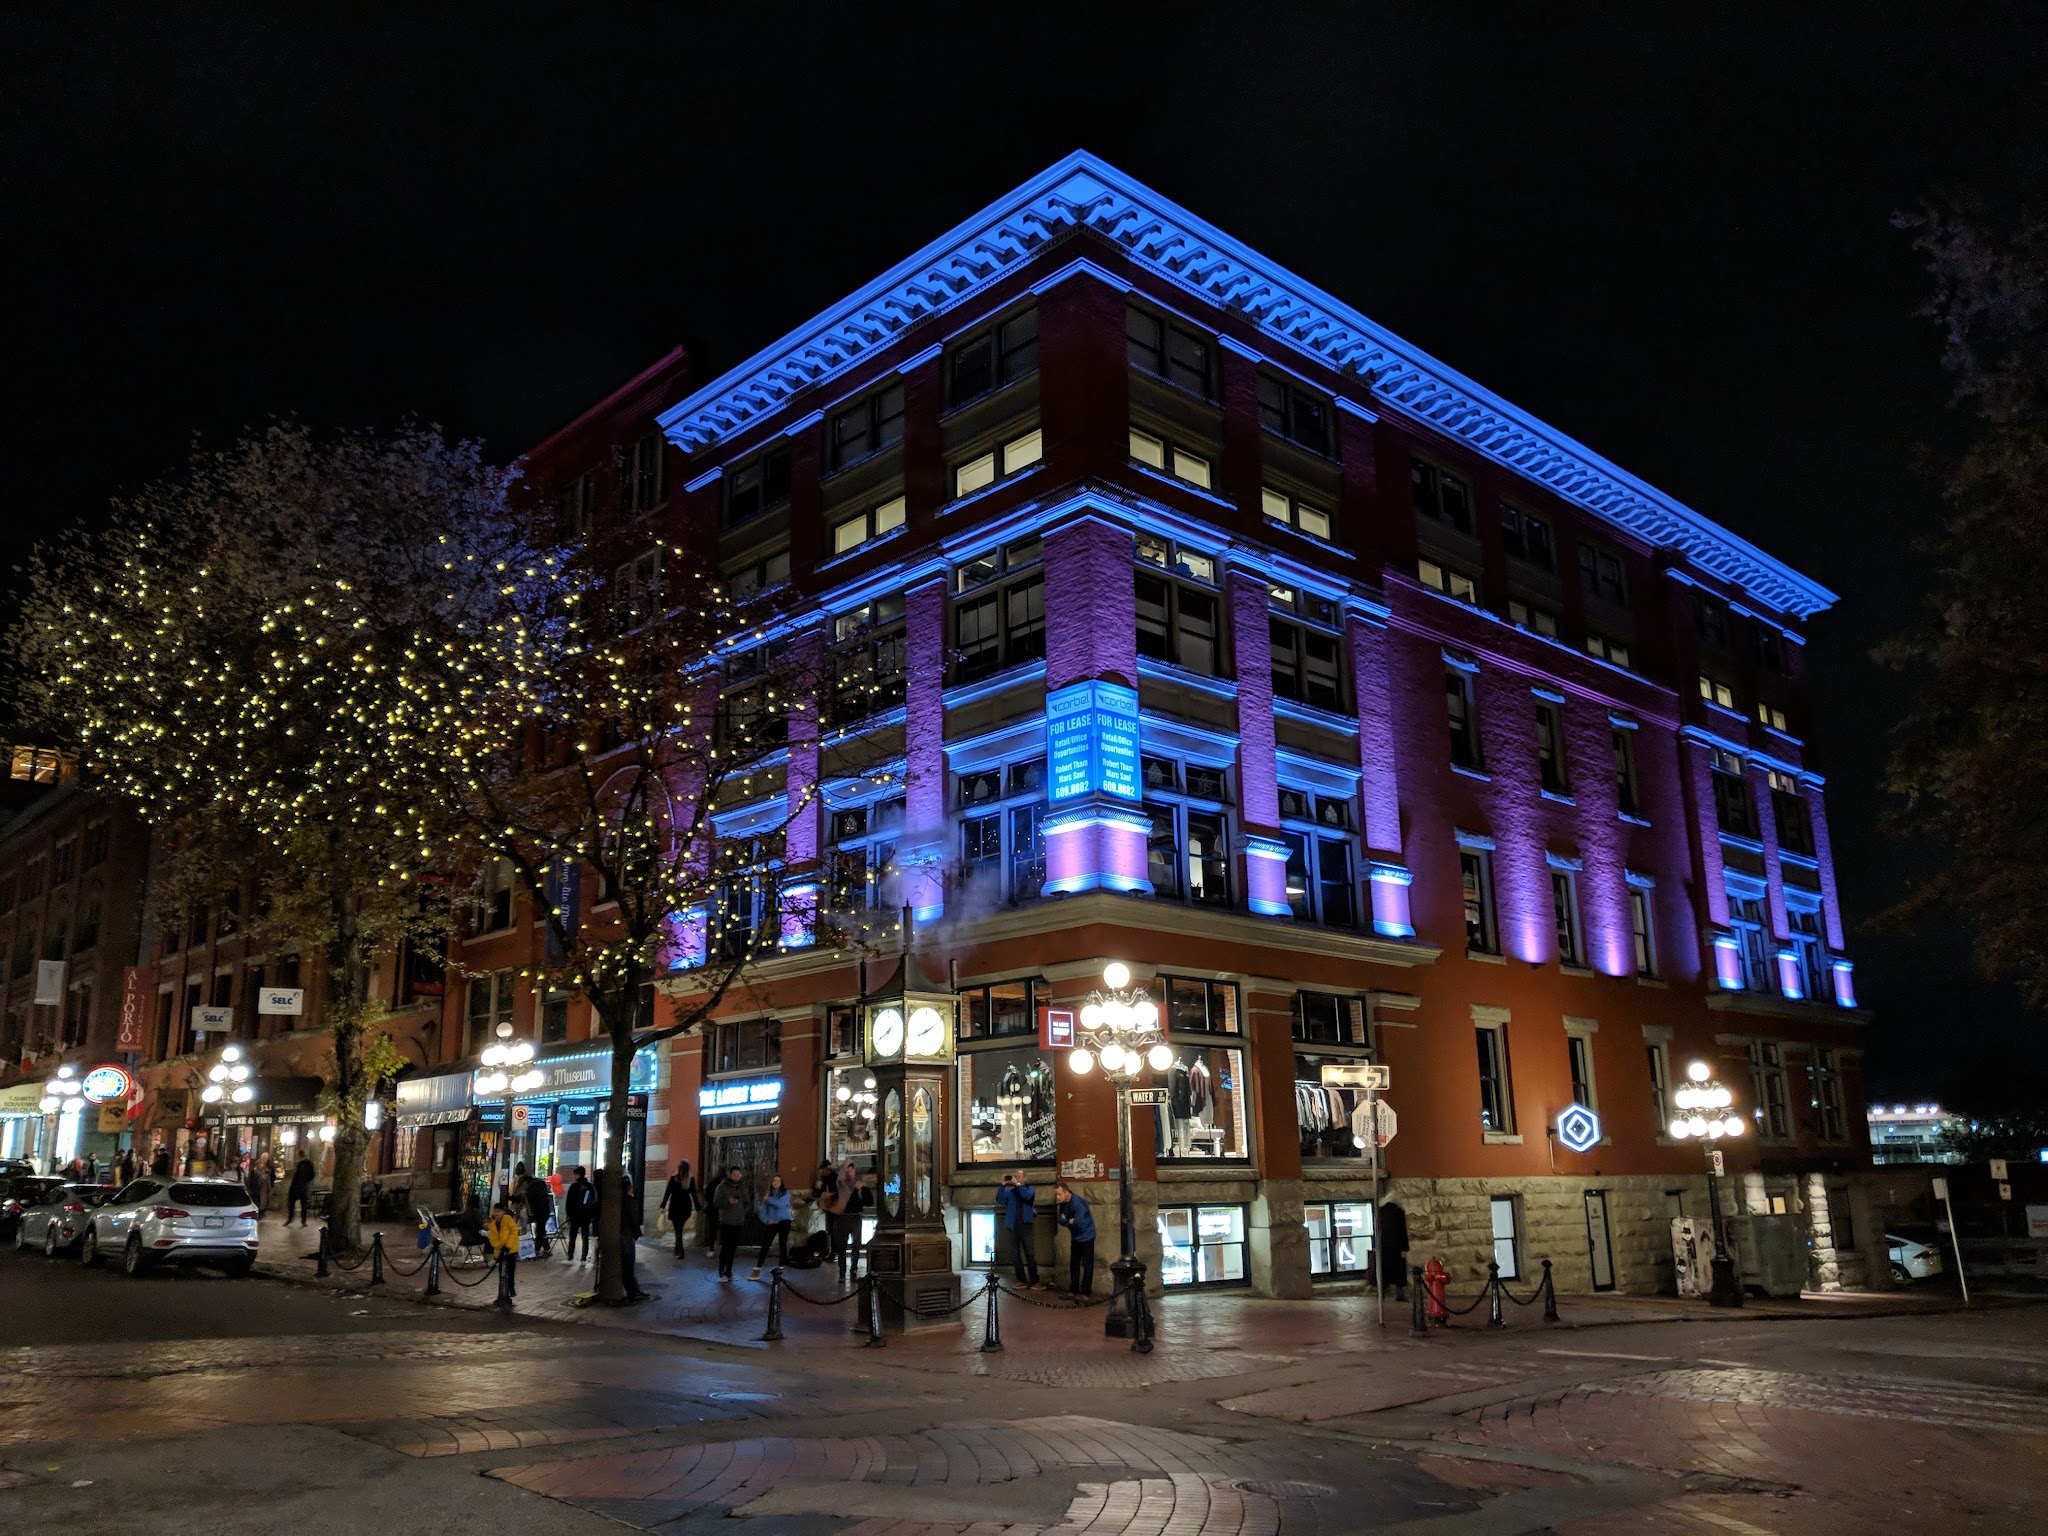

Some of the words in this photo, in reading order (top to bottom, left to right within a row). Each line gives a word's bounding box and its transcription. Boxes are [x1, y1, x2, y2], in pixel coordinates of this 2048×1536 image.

[1058, 693, 1090, 711] corbel
[1105, 697, 1134, 711] corbel
[1050, 722, 1065, 736] FOR
[1067, 713, 1091, 731] LEASE
[1097, 714, 1112, 728] FOR
[1114, 718, 1137, 734] LEASE
[1054, 744, 1089, 759] Opportunities
[1101, 742, 1134, 757] Opportunities
[1059, 774, 1072, 783] Marc
[1106, 769, 1119, 779] Marc
[128, 970, 137, 990] AL
[271, 997, 293, 1005] SELC
[120, 993, 135, 1043] PORTO
[203, 1015, 224, 1023] SELC
[554, 1069, 596, 1086] Museum
[1133, 1092, 1154, 1102] WATER
[226, 1115, 247, 1125] ARNE
[256, 1116, 273, 1124] VINO
[278, 1115, 301, 1123] STEAK
